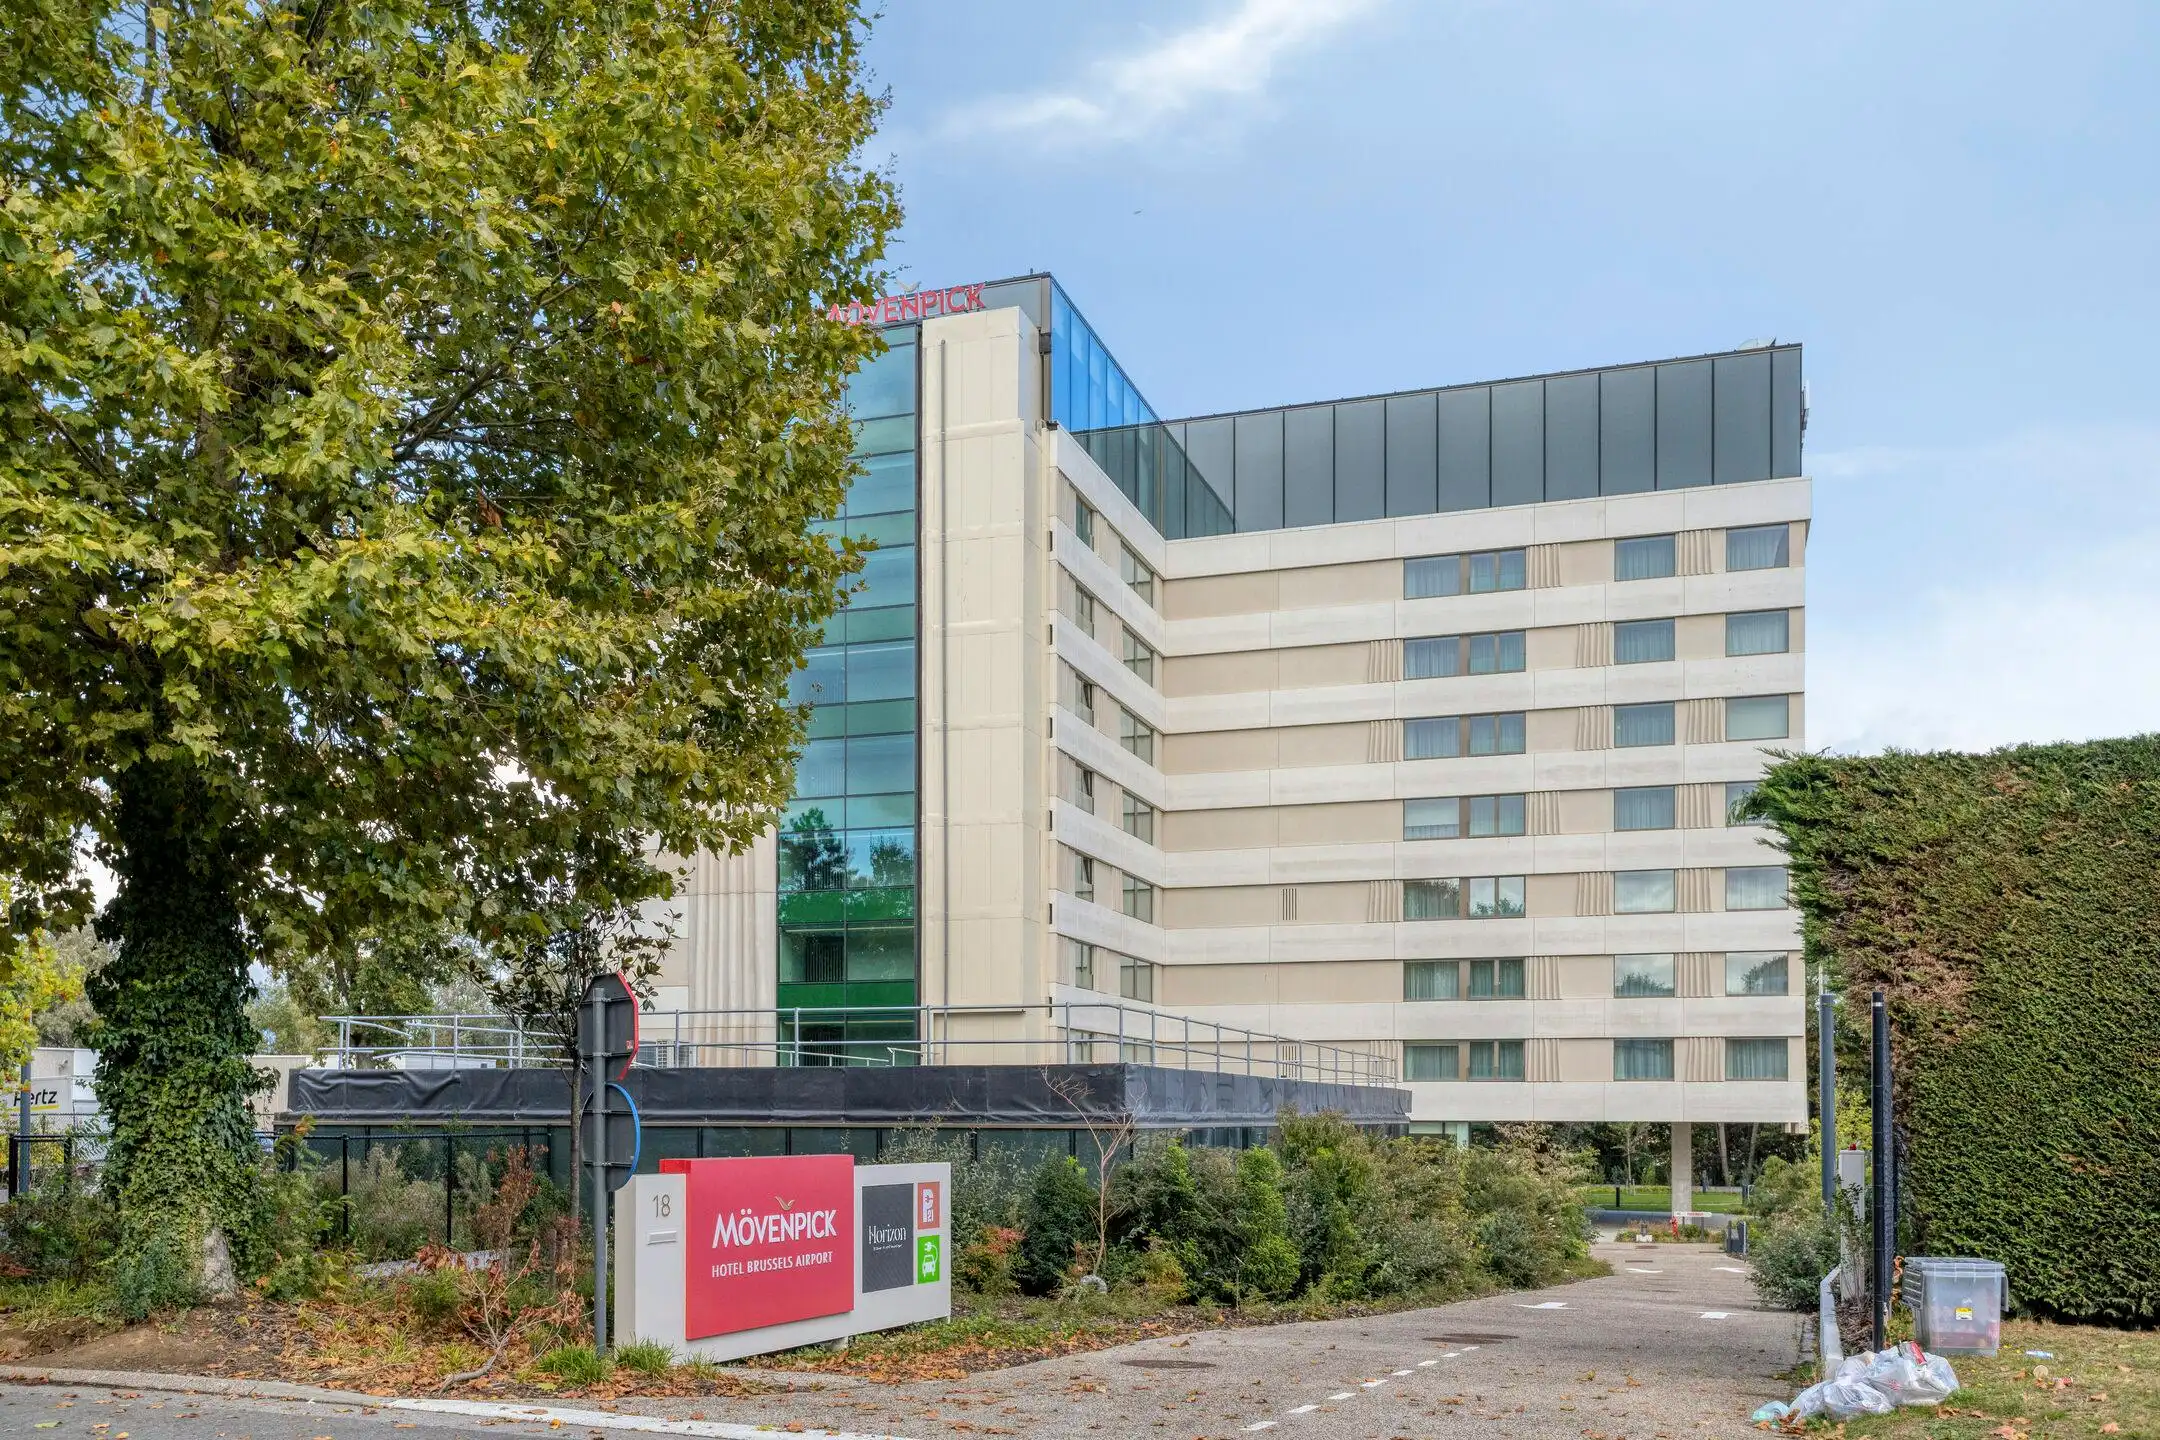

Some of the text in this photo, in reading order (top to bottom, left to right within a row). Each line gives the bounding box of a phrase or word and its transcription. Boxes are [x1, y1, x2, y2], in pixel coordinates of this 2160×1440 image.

[652, 1194, 671, 1218] 18
[711, 1208, 837, 1249] MÖVENPICK
[868, 1223, 907, 1245] Horizon
[711, 1251, 833, 1278] HOTEL BRUSSELS AIRPORT
